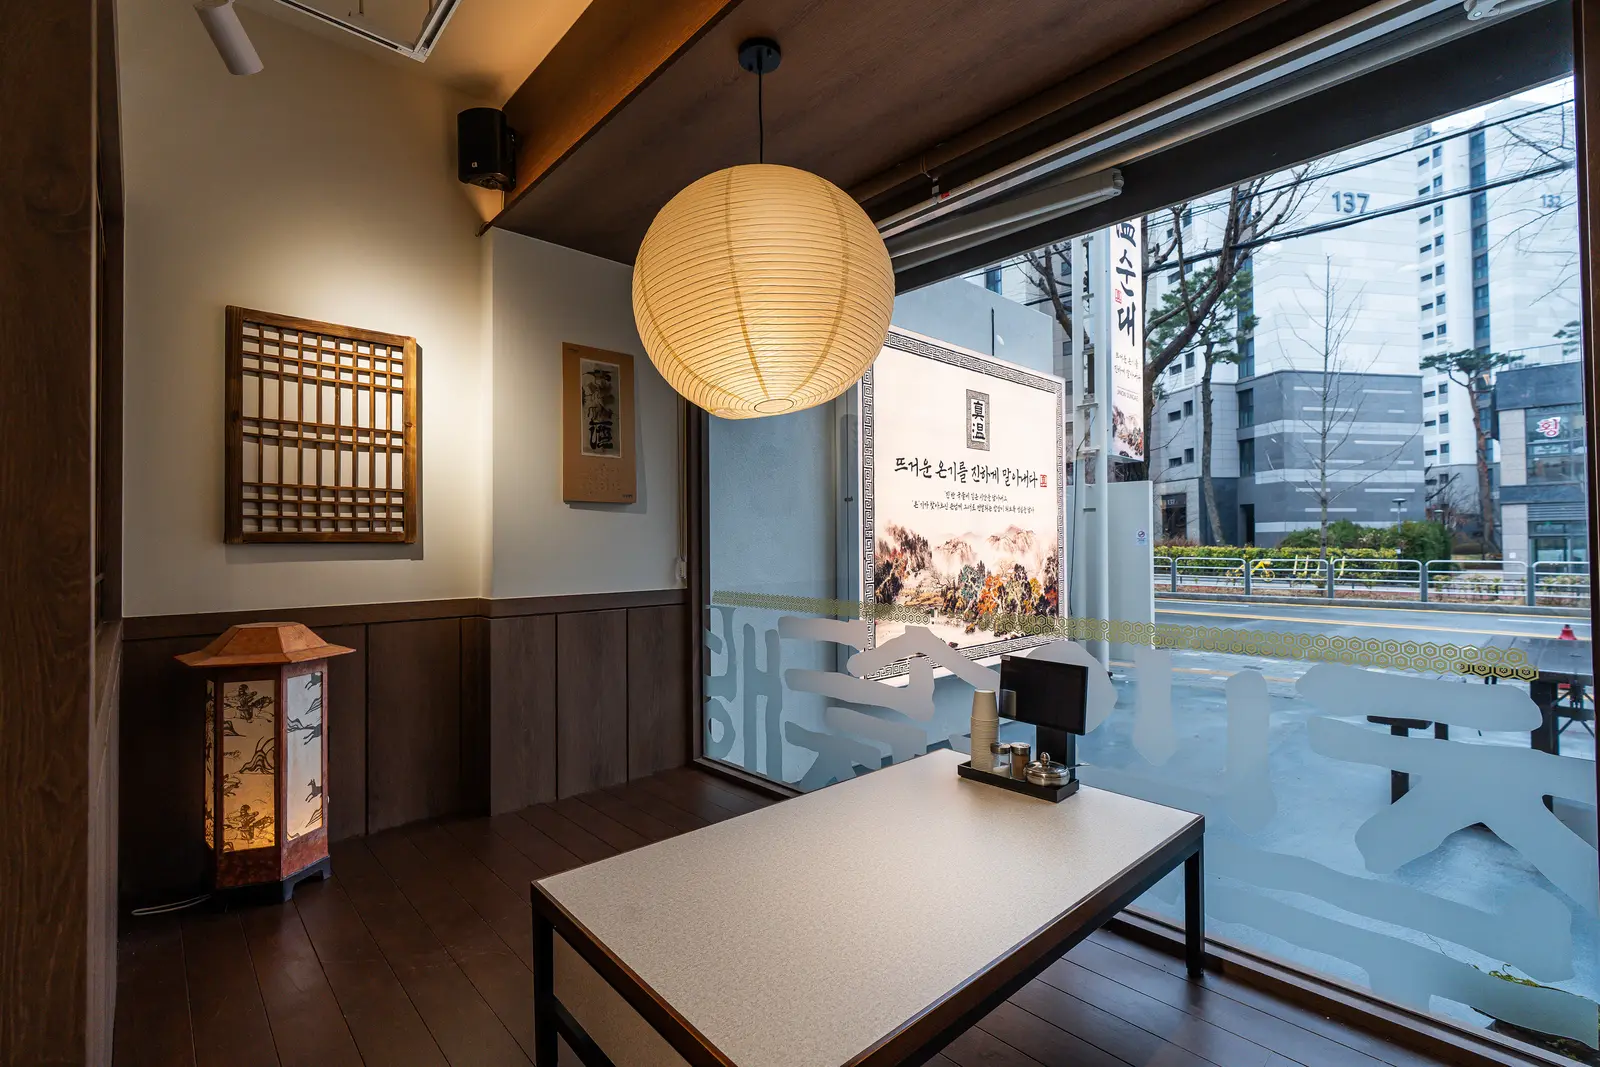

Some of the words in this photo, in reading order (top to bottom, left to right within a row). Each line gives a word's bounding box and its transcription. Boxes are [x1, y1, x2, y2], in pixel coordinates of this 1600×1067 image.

[1331, 190, 1370, 214] 137
[1540, 193, 1561, 208] 132
[894, 457, 932, 479] 뜨거운
[935, 460, 968, 483] 온기를
[971, 464, 999, 485] 진하게
[1002, 467, 1038, 488] 말아내다
